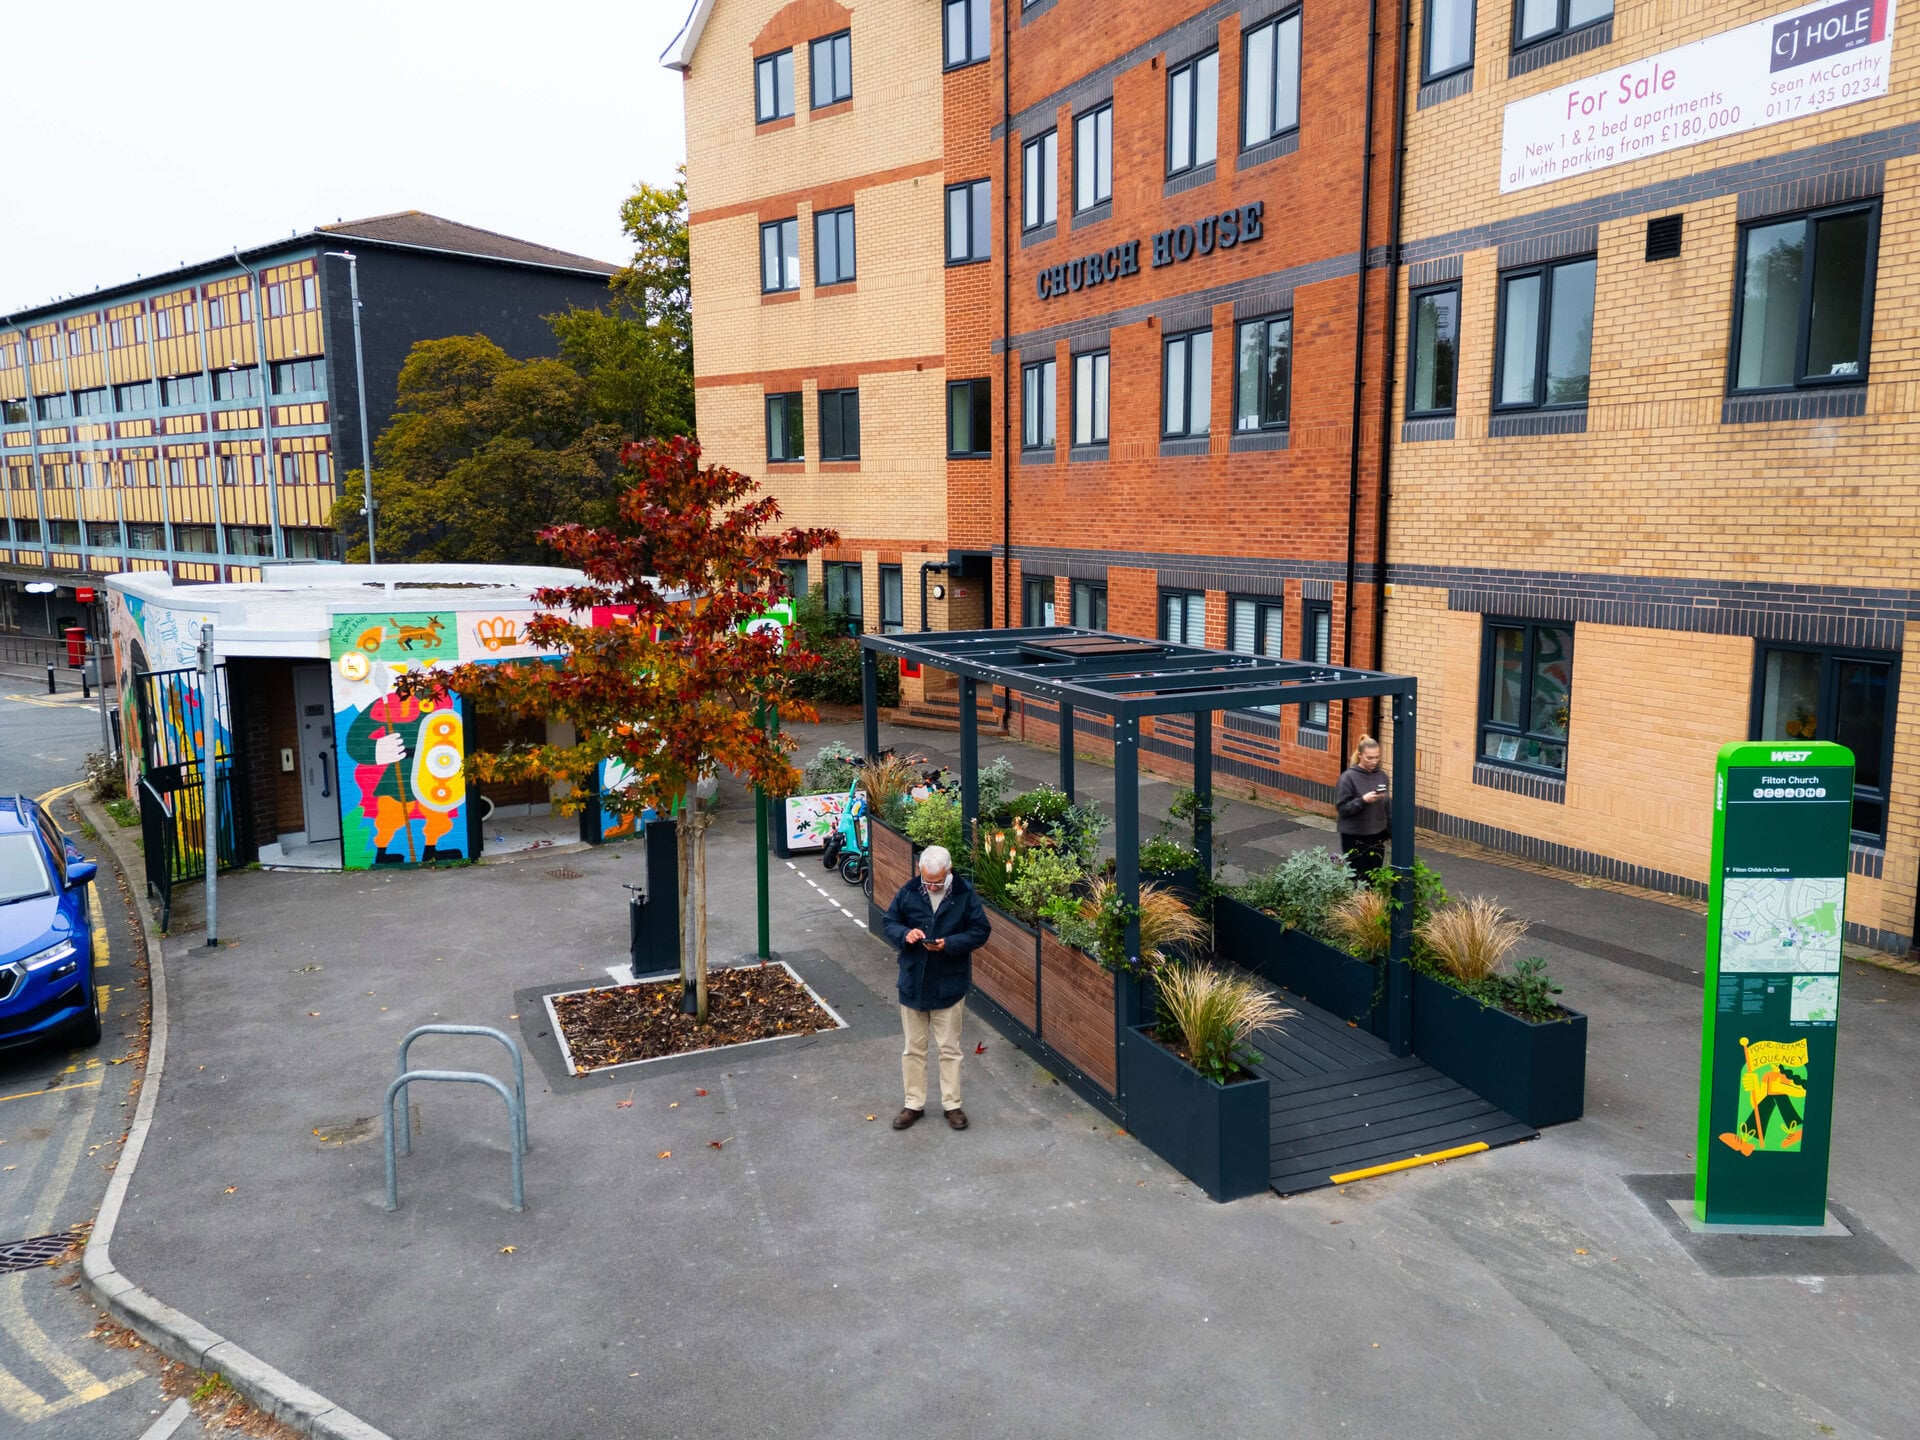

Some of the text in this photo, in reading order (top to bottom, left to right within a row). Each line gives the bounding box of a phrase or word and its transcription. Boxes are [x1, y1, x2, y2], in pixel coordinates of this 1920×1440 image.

[1806, 7, 1870, 47] HOLE
[1567, 63, 1676, 120] For Sale
[1766, 75, 1881, 117] 0117 435 0234
[1770, 55, 1882, 96] Sean McCarthy
[1509, 105, 1741, 184] all with parking from £180,000
[1525, 90, 1723, 160] New 1 & 2 bed apartments
[1036, 200, 1264, 300] CHURCH HOUSE
[1770, 750, 1812, 762] WEST
[1761, 776, 1819, 784] Filton Church
[1752, 1054, 1806, 1068] JOURNEY
